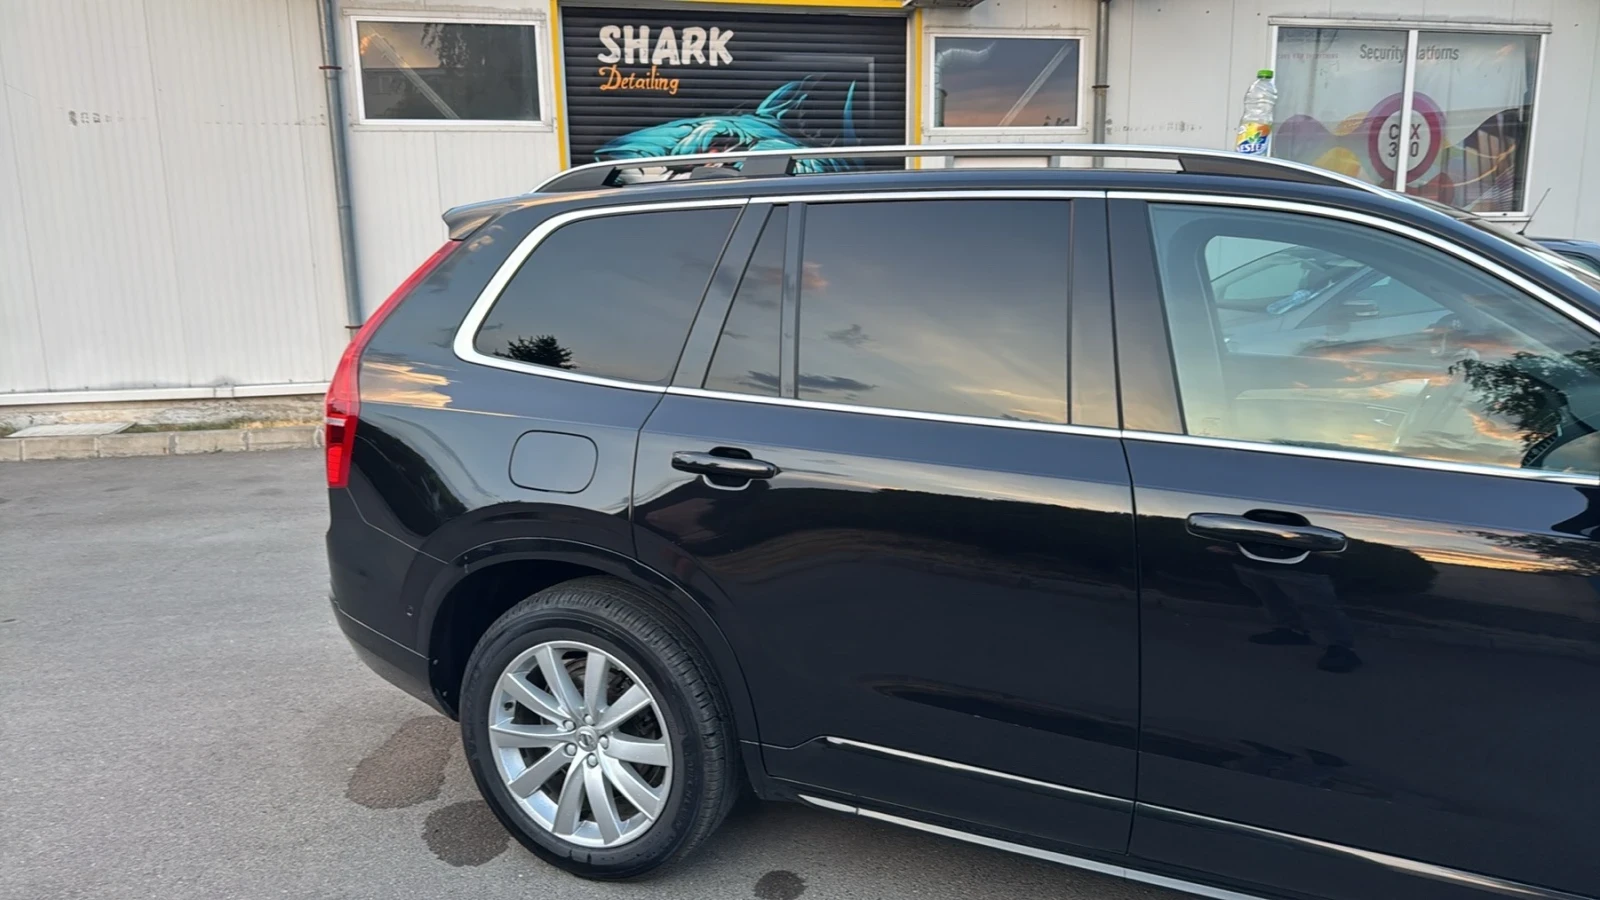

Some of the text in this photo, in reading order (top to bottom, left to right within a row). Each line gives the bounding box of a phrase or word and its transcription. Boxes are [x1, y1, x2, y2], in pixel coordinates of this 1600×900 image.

[597, 25, 734, 66] SHARK
[1360, 44, 1404, 63] Security
[1416, 44, 1460, 61] latforms
[598, 64, 680, 95] Detailing
[1388, 123, 1421, 140] CX
[1388, 141, 1419, 158] 30
